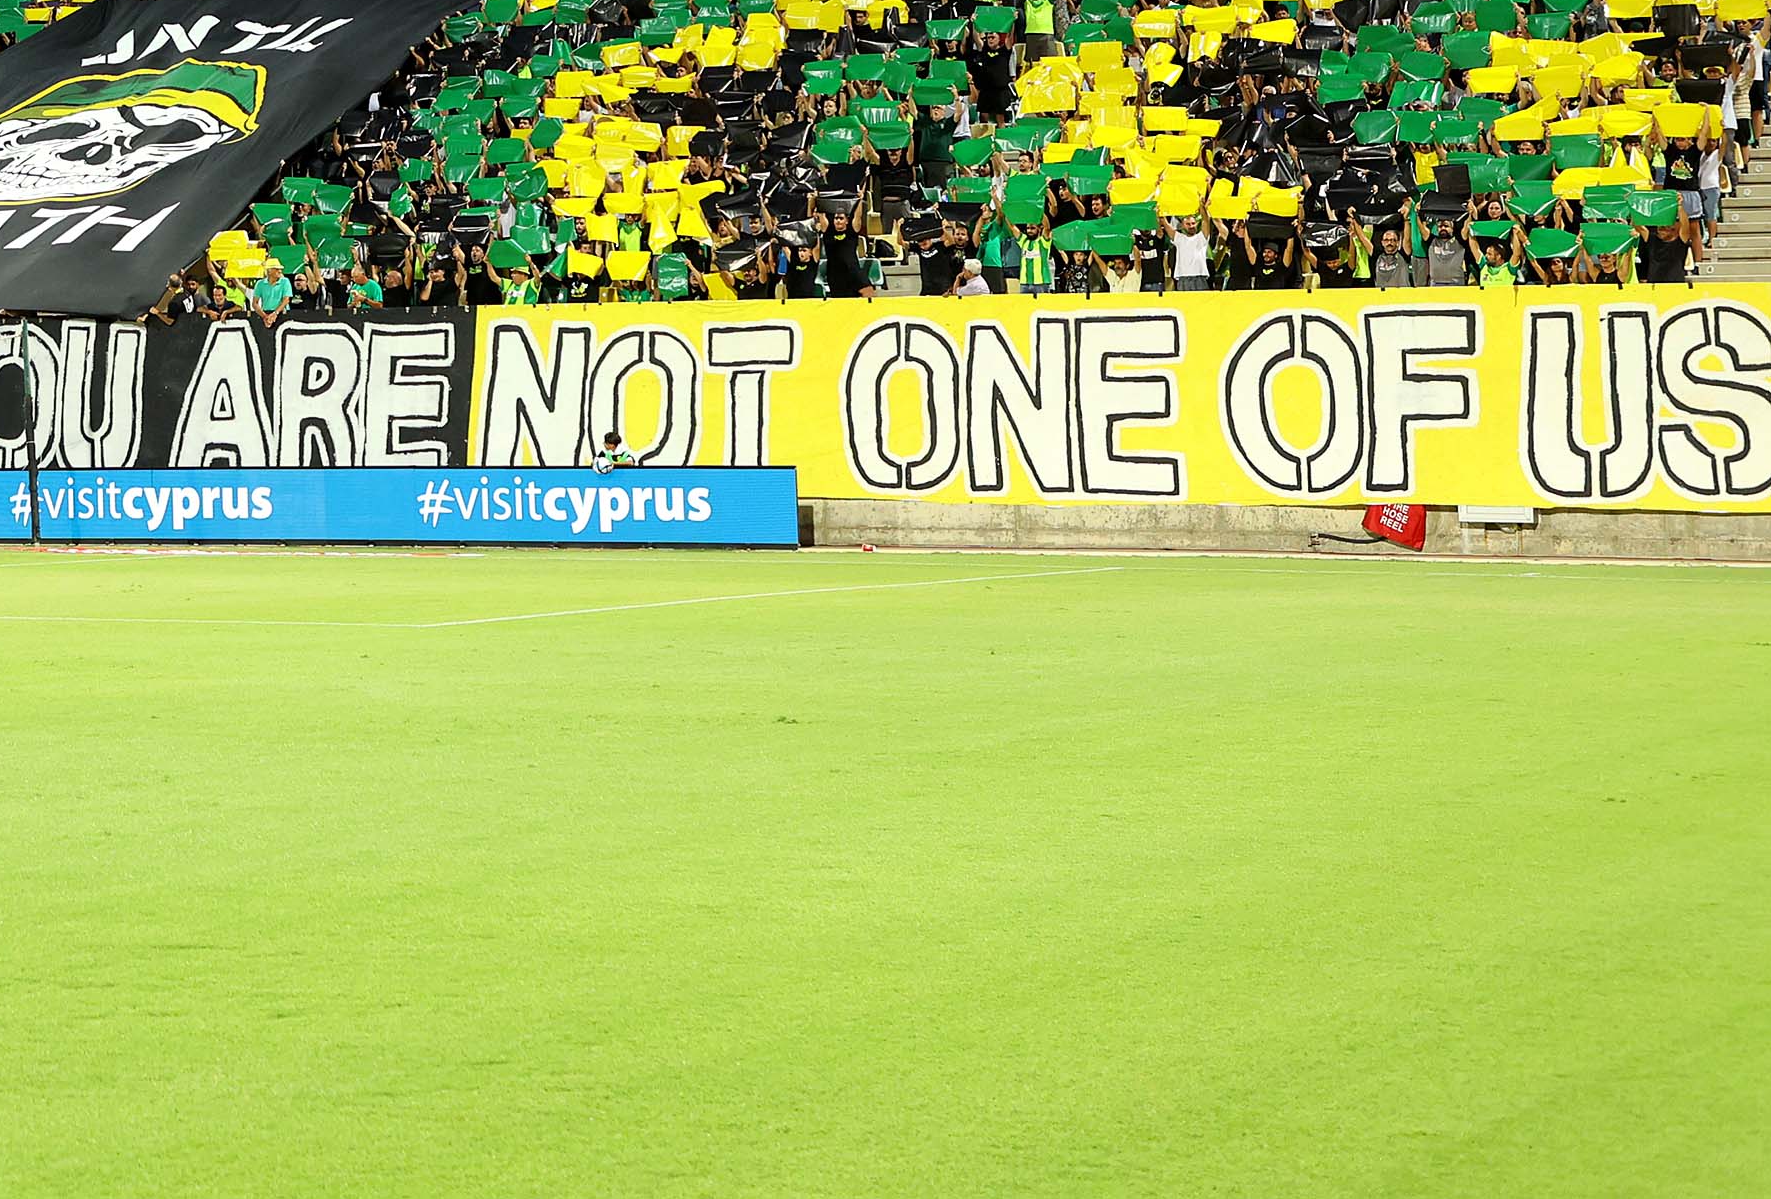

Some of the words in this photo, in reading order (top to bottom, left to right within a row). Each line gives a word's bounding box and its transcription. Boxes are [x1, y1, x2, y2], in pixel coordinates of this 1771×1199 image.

[168, 318, 456, 468] ARE
[466, 317, 802, 468] NOT
[840, 309, 1185, 498] ONE
[1219, 304, 1483, 500] OF
[1520, 299, 1771, 503] US
[9, 479, 273, 530] #visitcyprus
[417, 476, 712, 534] #visitcyprus
[1379, 515, 1404, 533] REEL
[1382, 506, 1409, 524] HOSE
